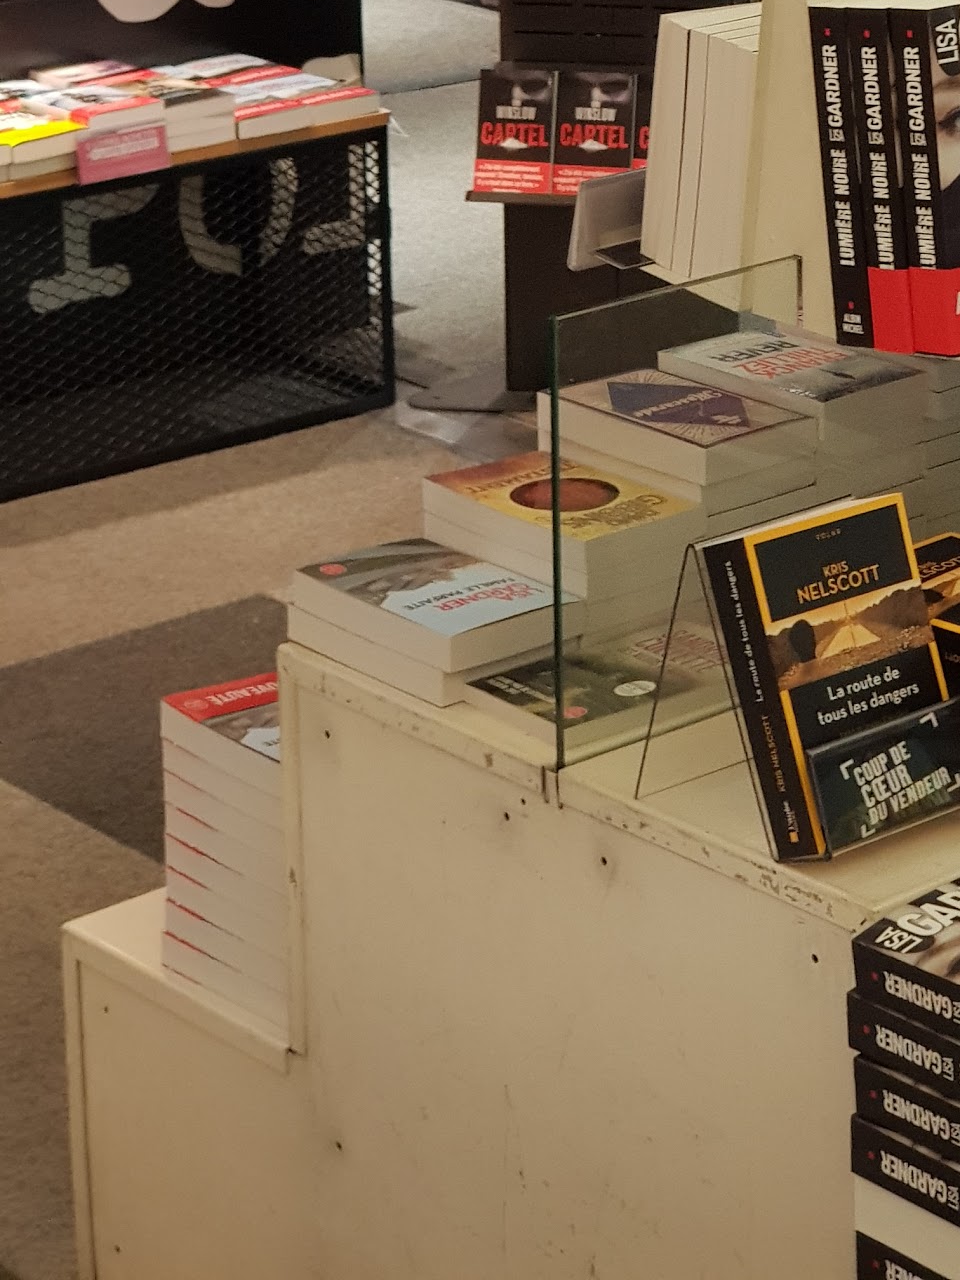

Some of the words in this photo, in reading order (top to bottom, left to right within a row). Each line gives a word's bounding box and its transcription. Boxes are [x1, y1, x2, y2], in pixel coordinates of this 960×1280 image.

[936, 19, 960, 66] LISA
[480, 122, 549, 148] CARTEL
[559, 123, 629, 149] CARTEL
[832, 147, 850, 197] NOIRE
[870, 151, 890, 200] NOIRE
[723, 560, 741, 597] dangers
[796, 564, 880, 604] NELSCOTT
[822, 560, 849, 577] KRIS
[827, 686, 844, 701] La
[847, 672, 882, 697] route
[884, 666, 900, 681] de
[848, 700, 869, 717] les
[869, 682, 920, 711] dangers
[853, 754, 888, 787] COUP
[860, 766, 912, 805] CŒUR
[891, 767, 951, 814] VENDEUR
[883, 969, 953, 1021] GARDNER
[874, 1023, 943, 1077] GARDNER
